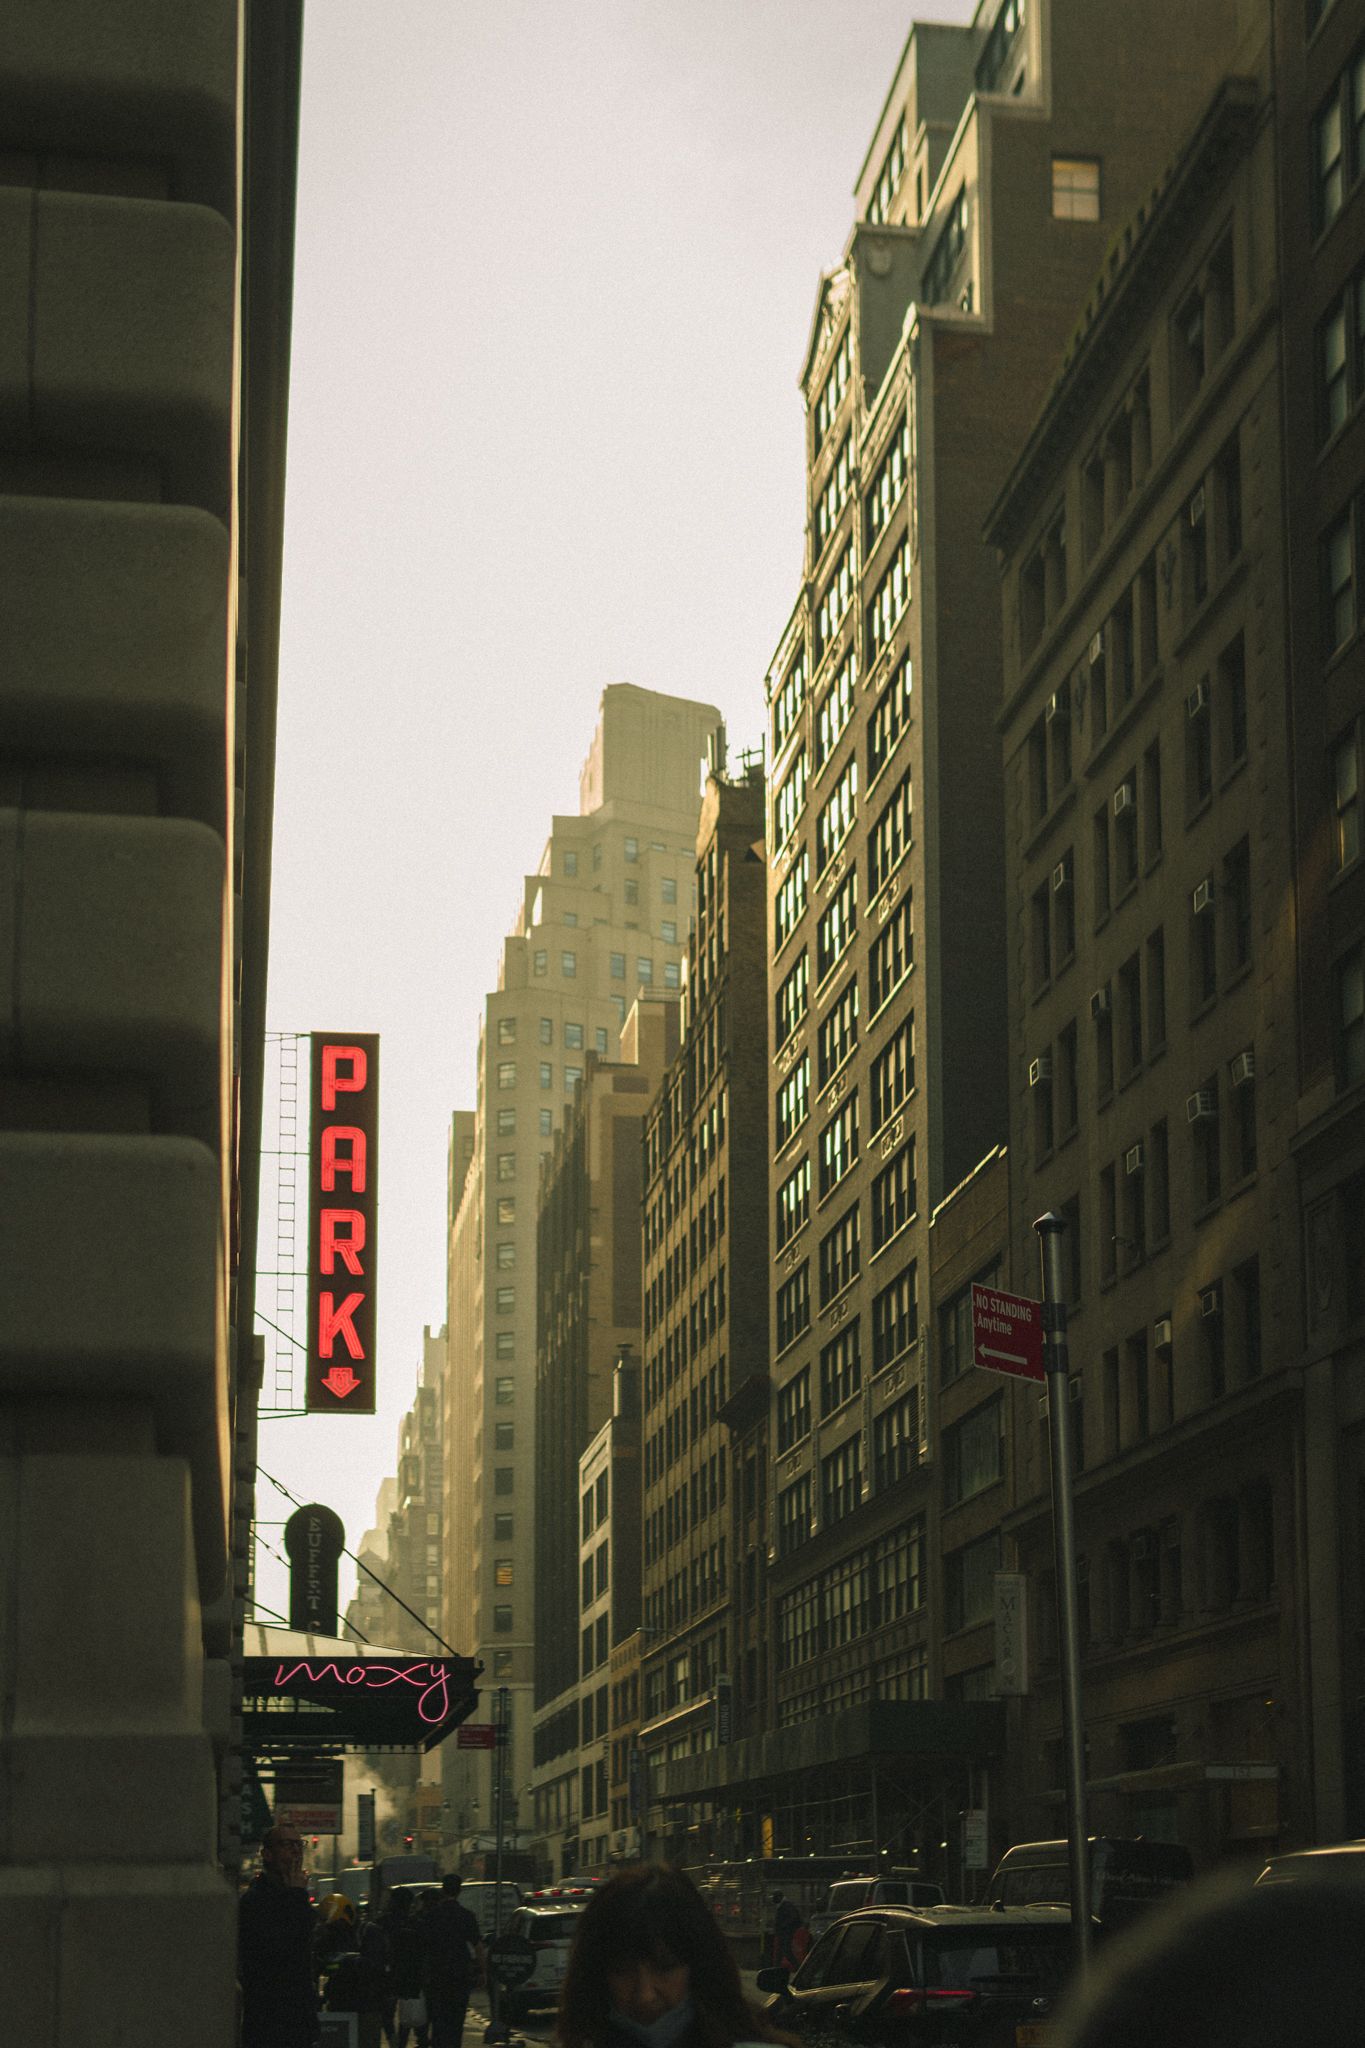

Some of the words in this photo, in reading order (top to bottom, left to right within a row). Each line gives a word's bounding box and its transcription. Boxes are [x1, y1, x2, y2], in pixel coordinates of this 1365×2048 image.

[318, 1045, 367, 1360] PARK
[976, 1293, 989, 1311] NO
[990, 1298, 1032, 1322] STANDING
[977, 1312, 1013, 1335] Anytime
